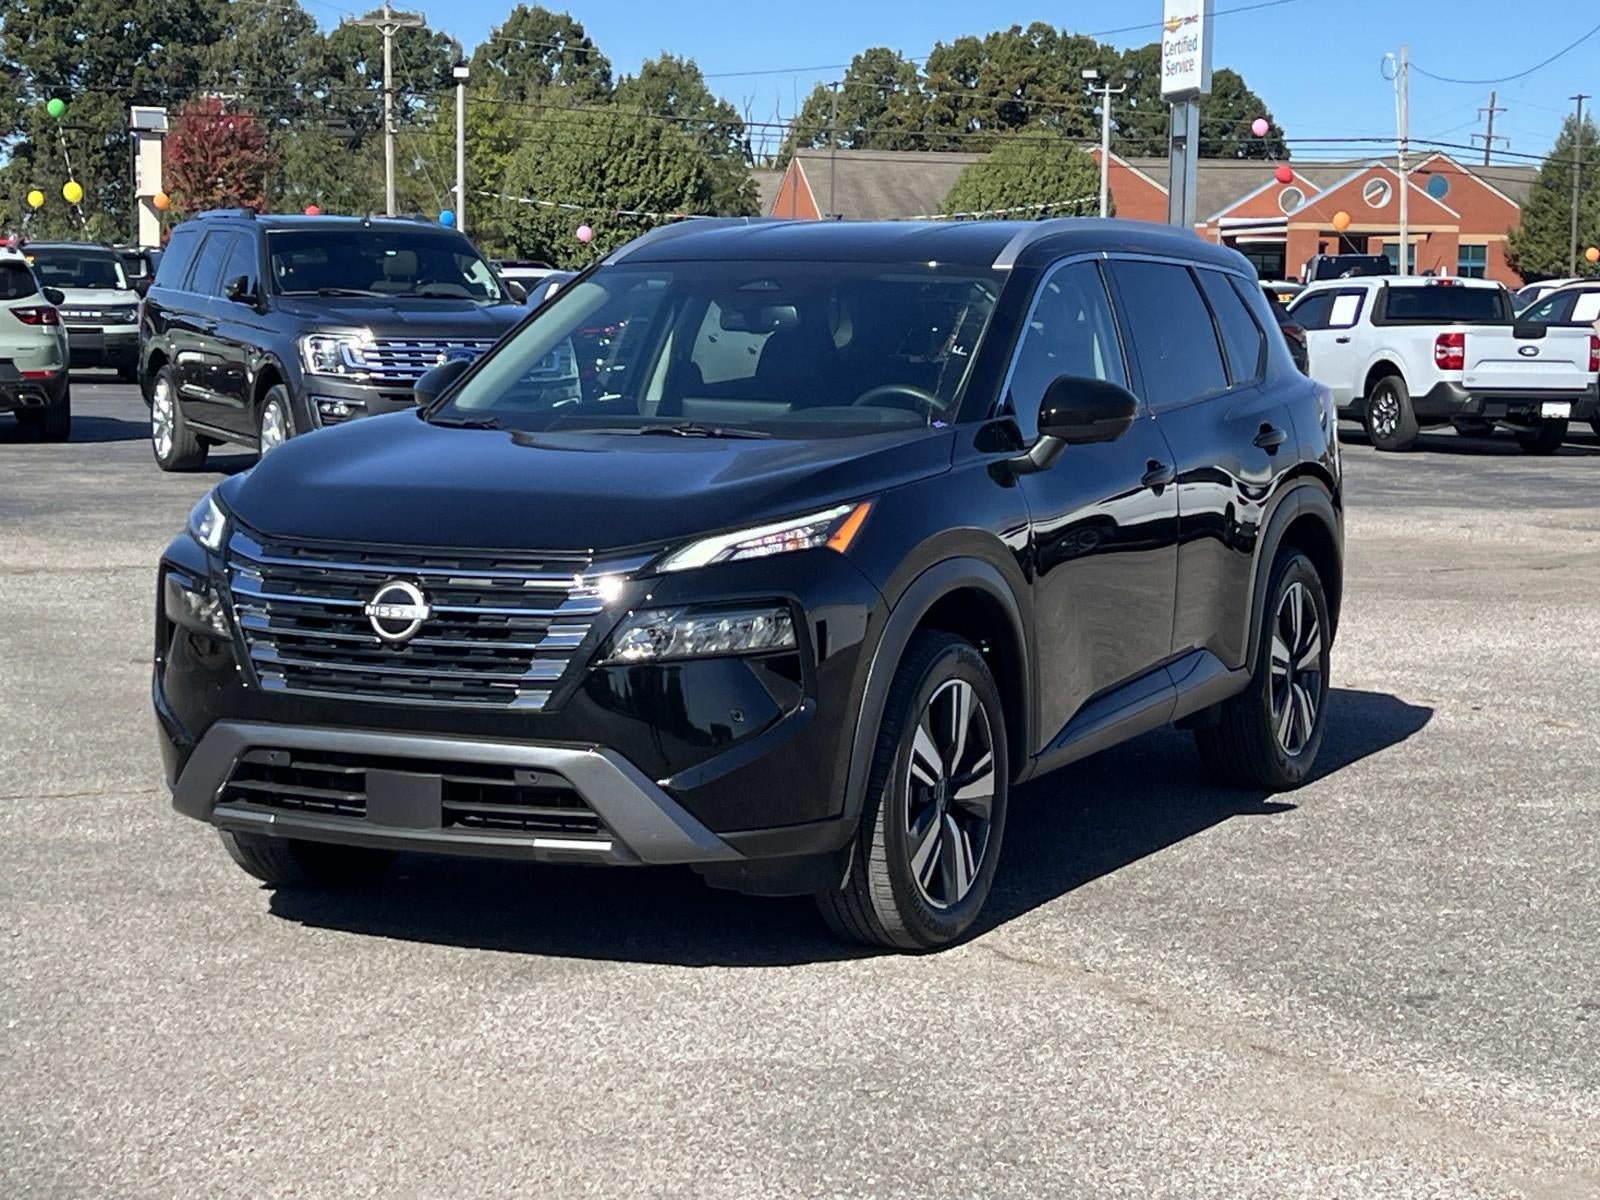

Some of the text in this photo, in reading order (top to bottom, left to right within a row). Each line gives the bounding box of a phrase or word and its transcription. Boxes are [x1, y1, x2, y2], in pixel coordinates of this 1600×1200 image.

[1164, 33, 1198, 57] Certified
[1165, 59, 1194, 76] Service
[365, 605, 429, 619] NISSAN
